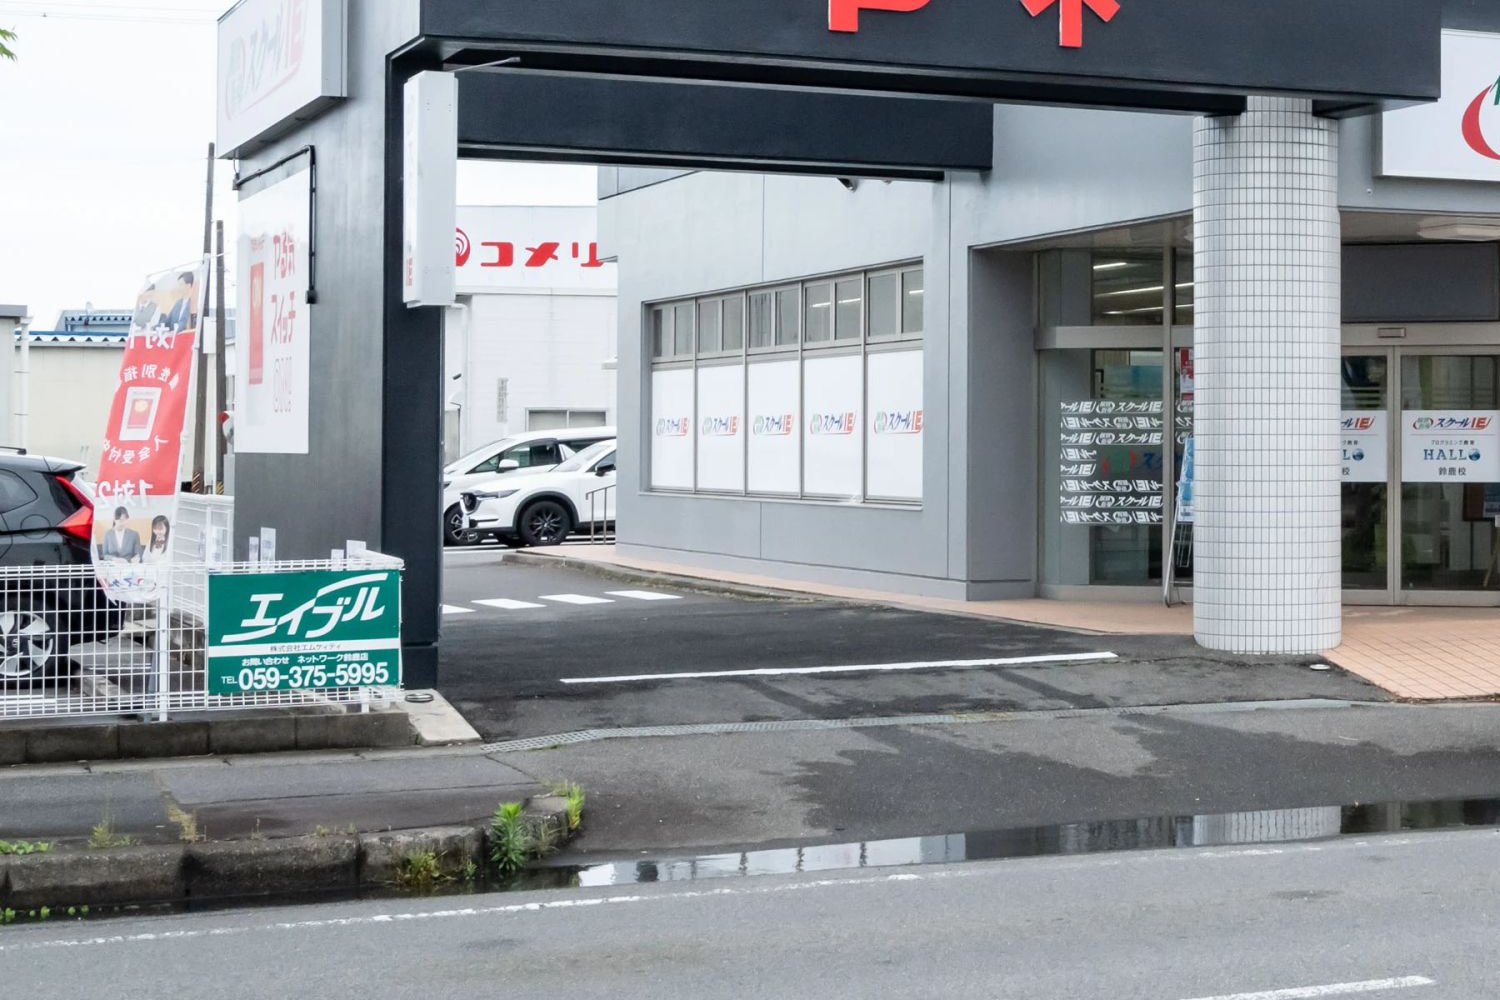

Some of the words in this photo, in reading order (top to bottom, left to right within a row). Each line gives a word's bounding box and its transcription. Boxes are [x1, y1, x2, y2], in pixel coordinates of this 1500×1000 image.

[480, 242, 604, 267] コメリ
[230, 580, 388, 640] エイブル
[221, 676, 238, 684] TEL
[239, 662, 389, 690] 059-375-5995
